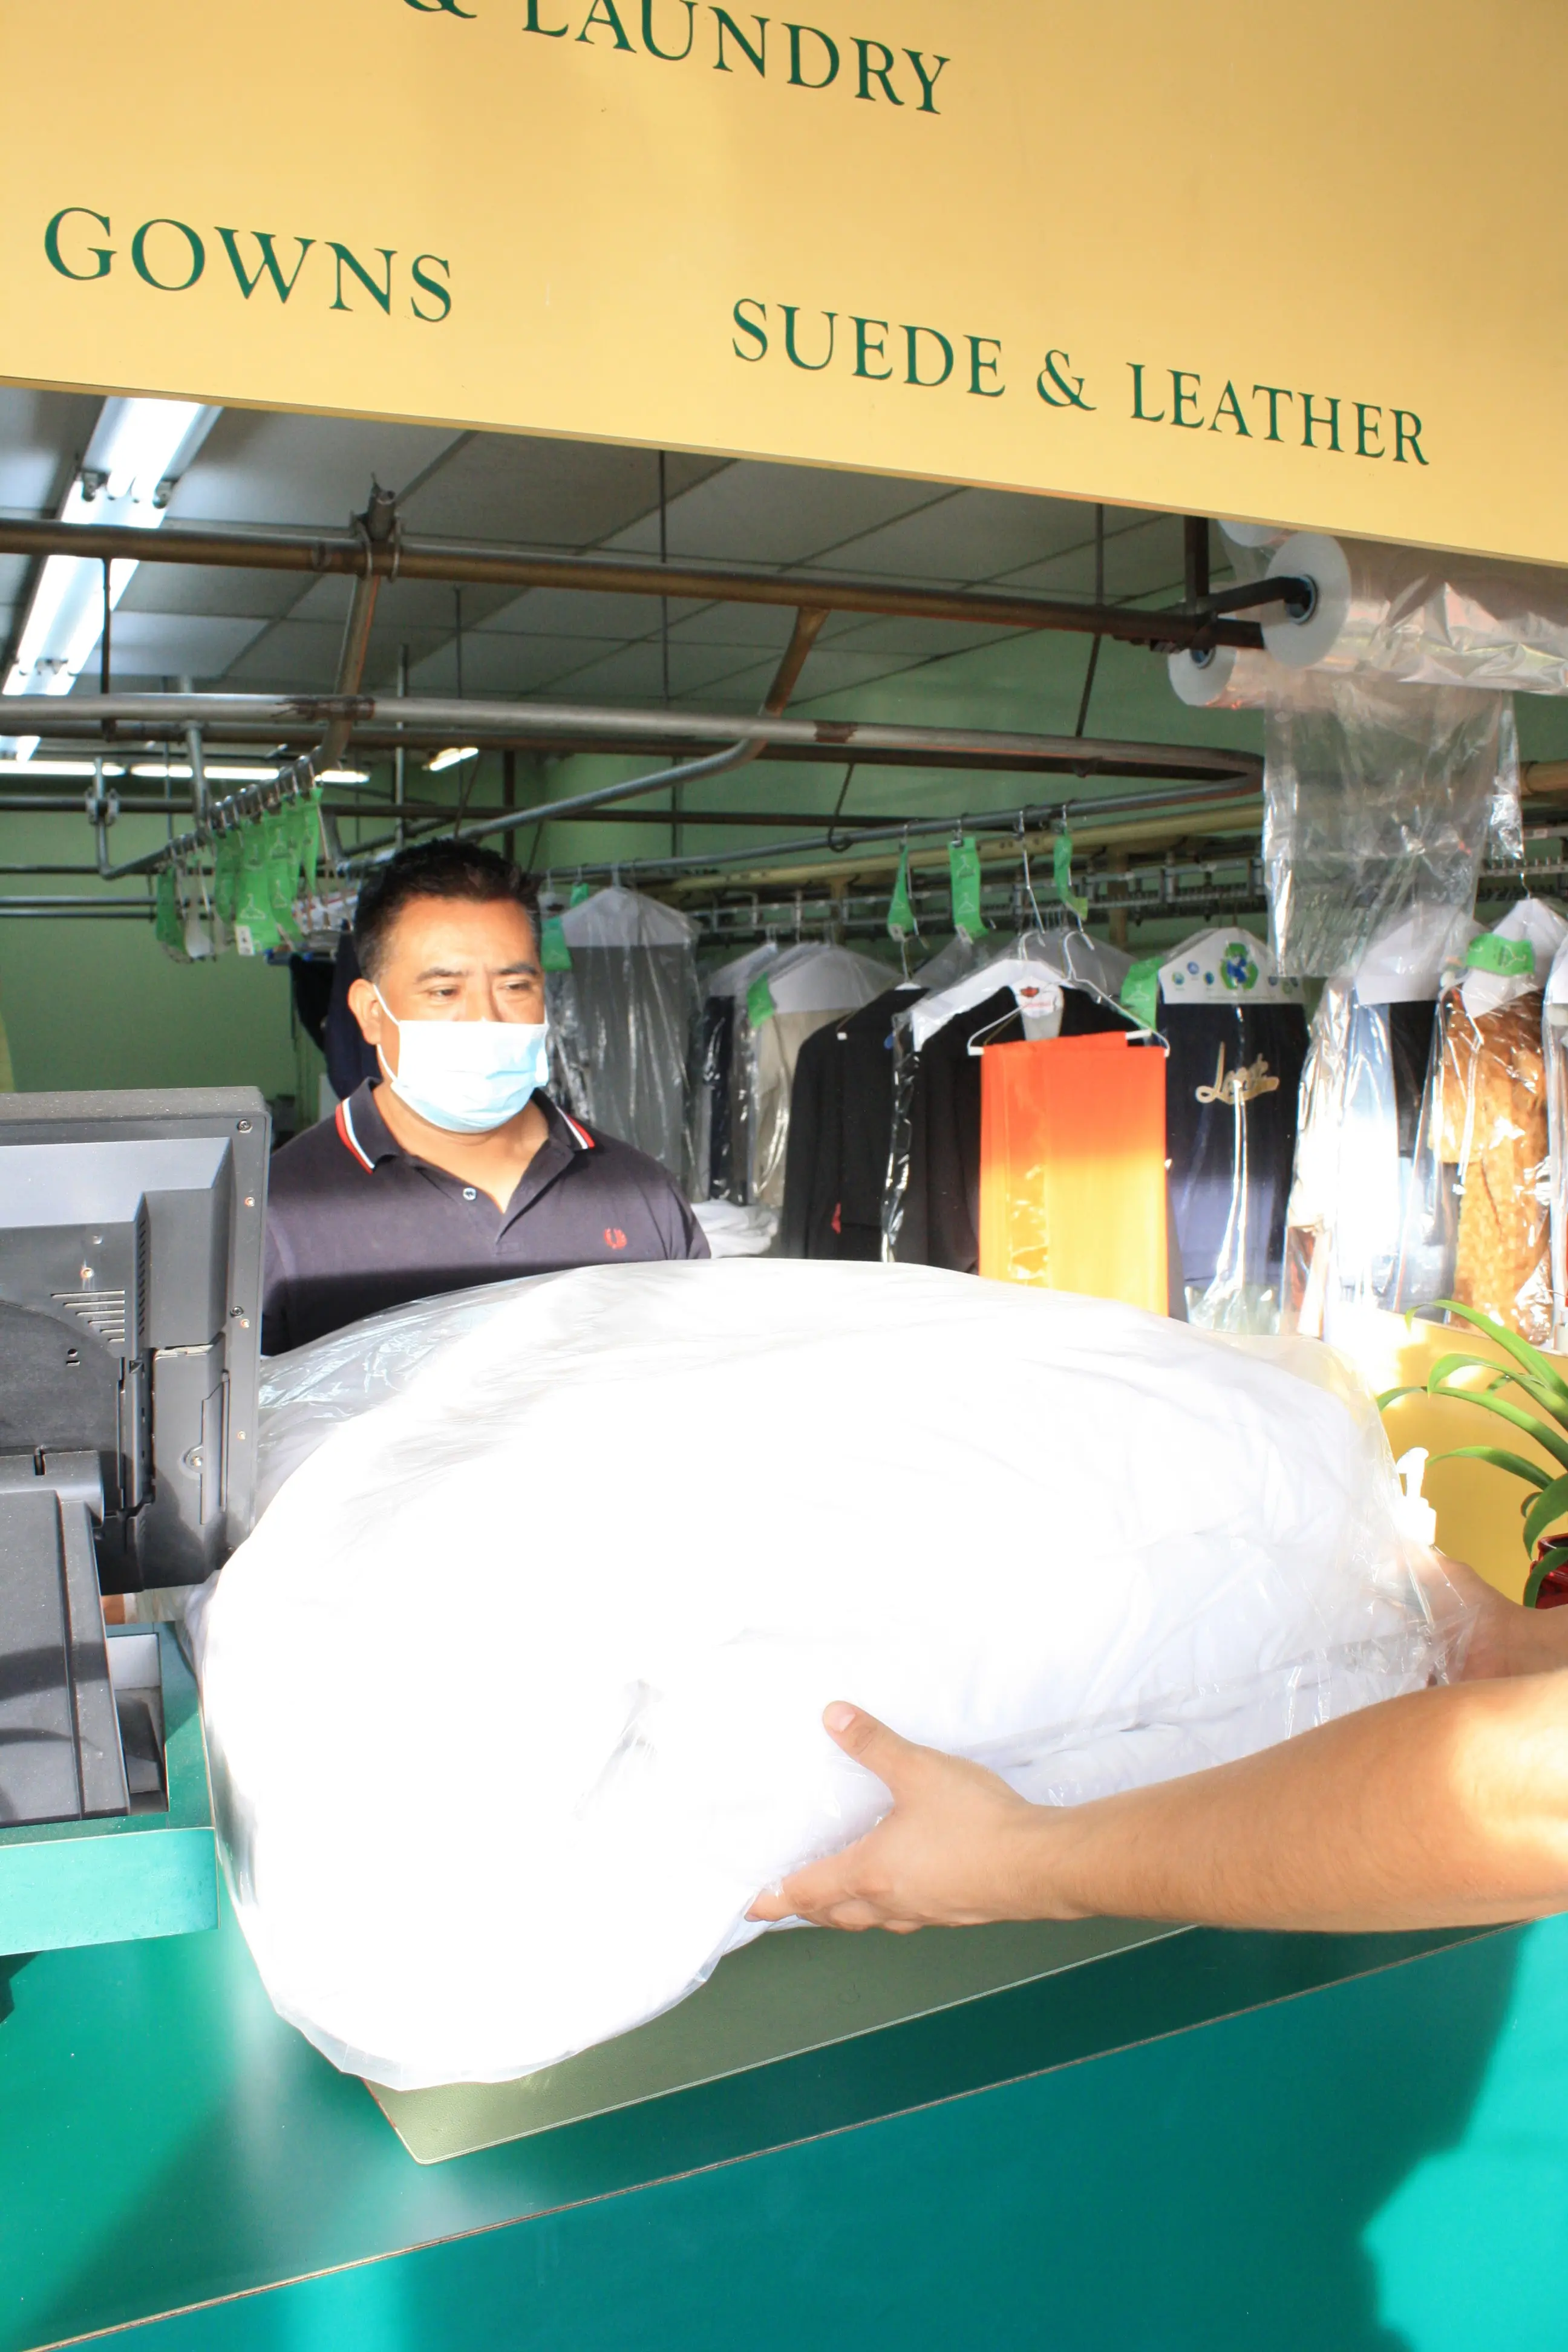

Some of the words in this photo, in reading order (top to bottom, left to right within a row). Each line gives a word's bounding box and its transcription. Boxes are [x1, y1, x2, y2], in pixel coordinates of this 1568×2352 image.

[522, 0, 950, 115] LAUNDRY
[44, 207, 451, 322] GOWNS
[733, 298, 1005, 397] SUEDE
[1036, 349, 1096, 411] &
[1127, 362, 1429, 466] LEATHER
